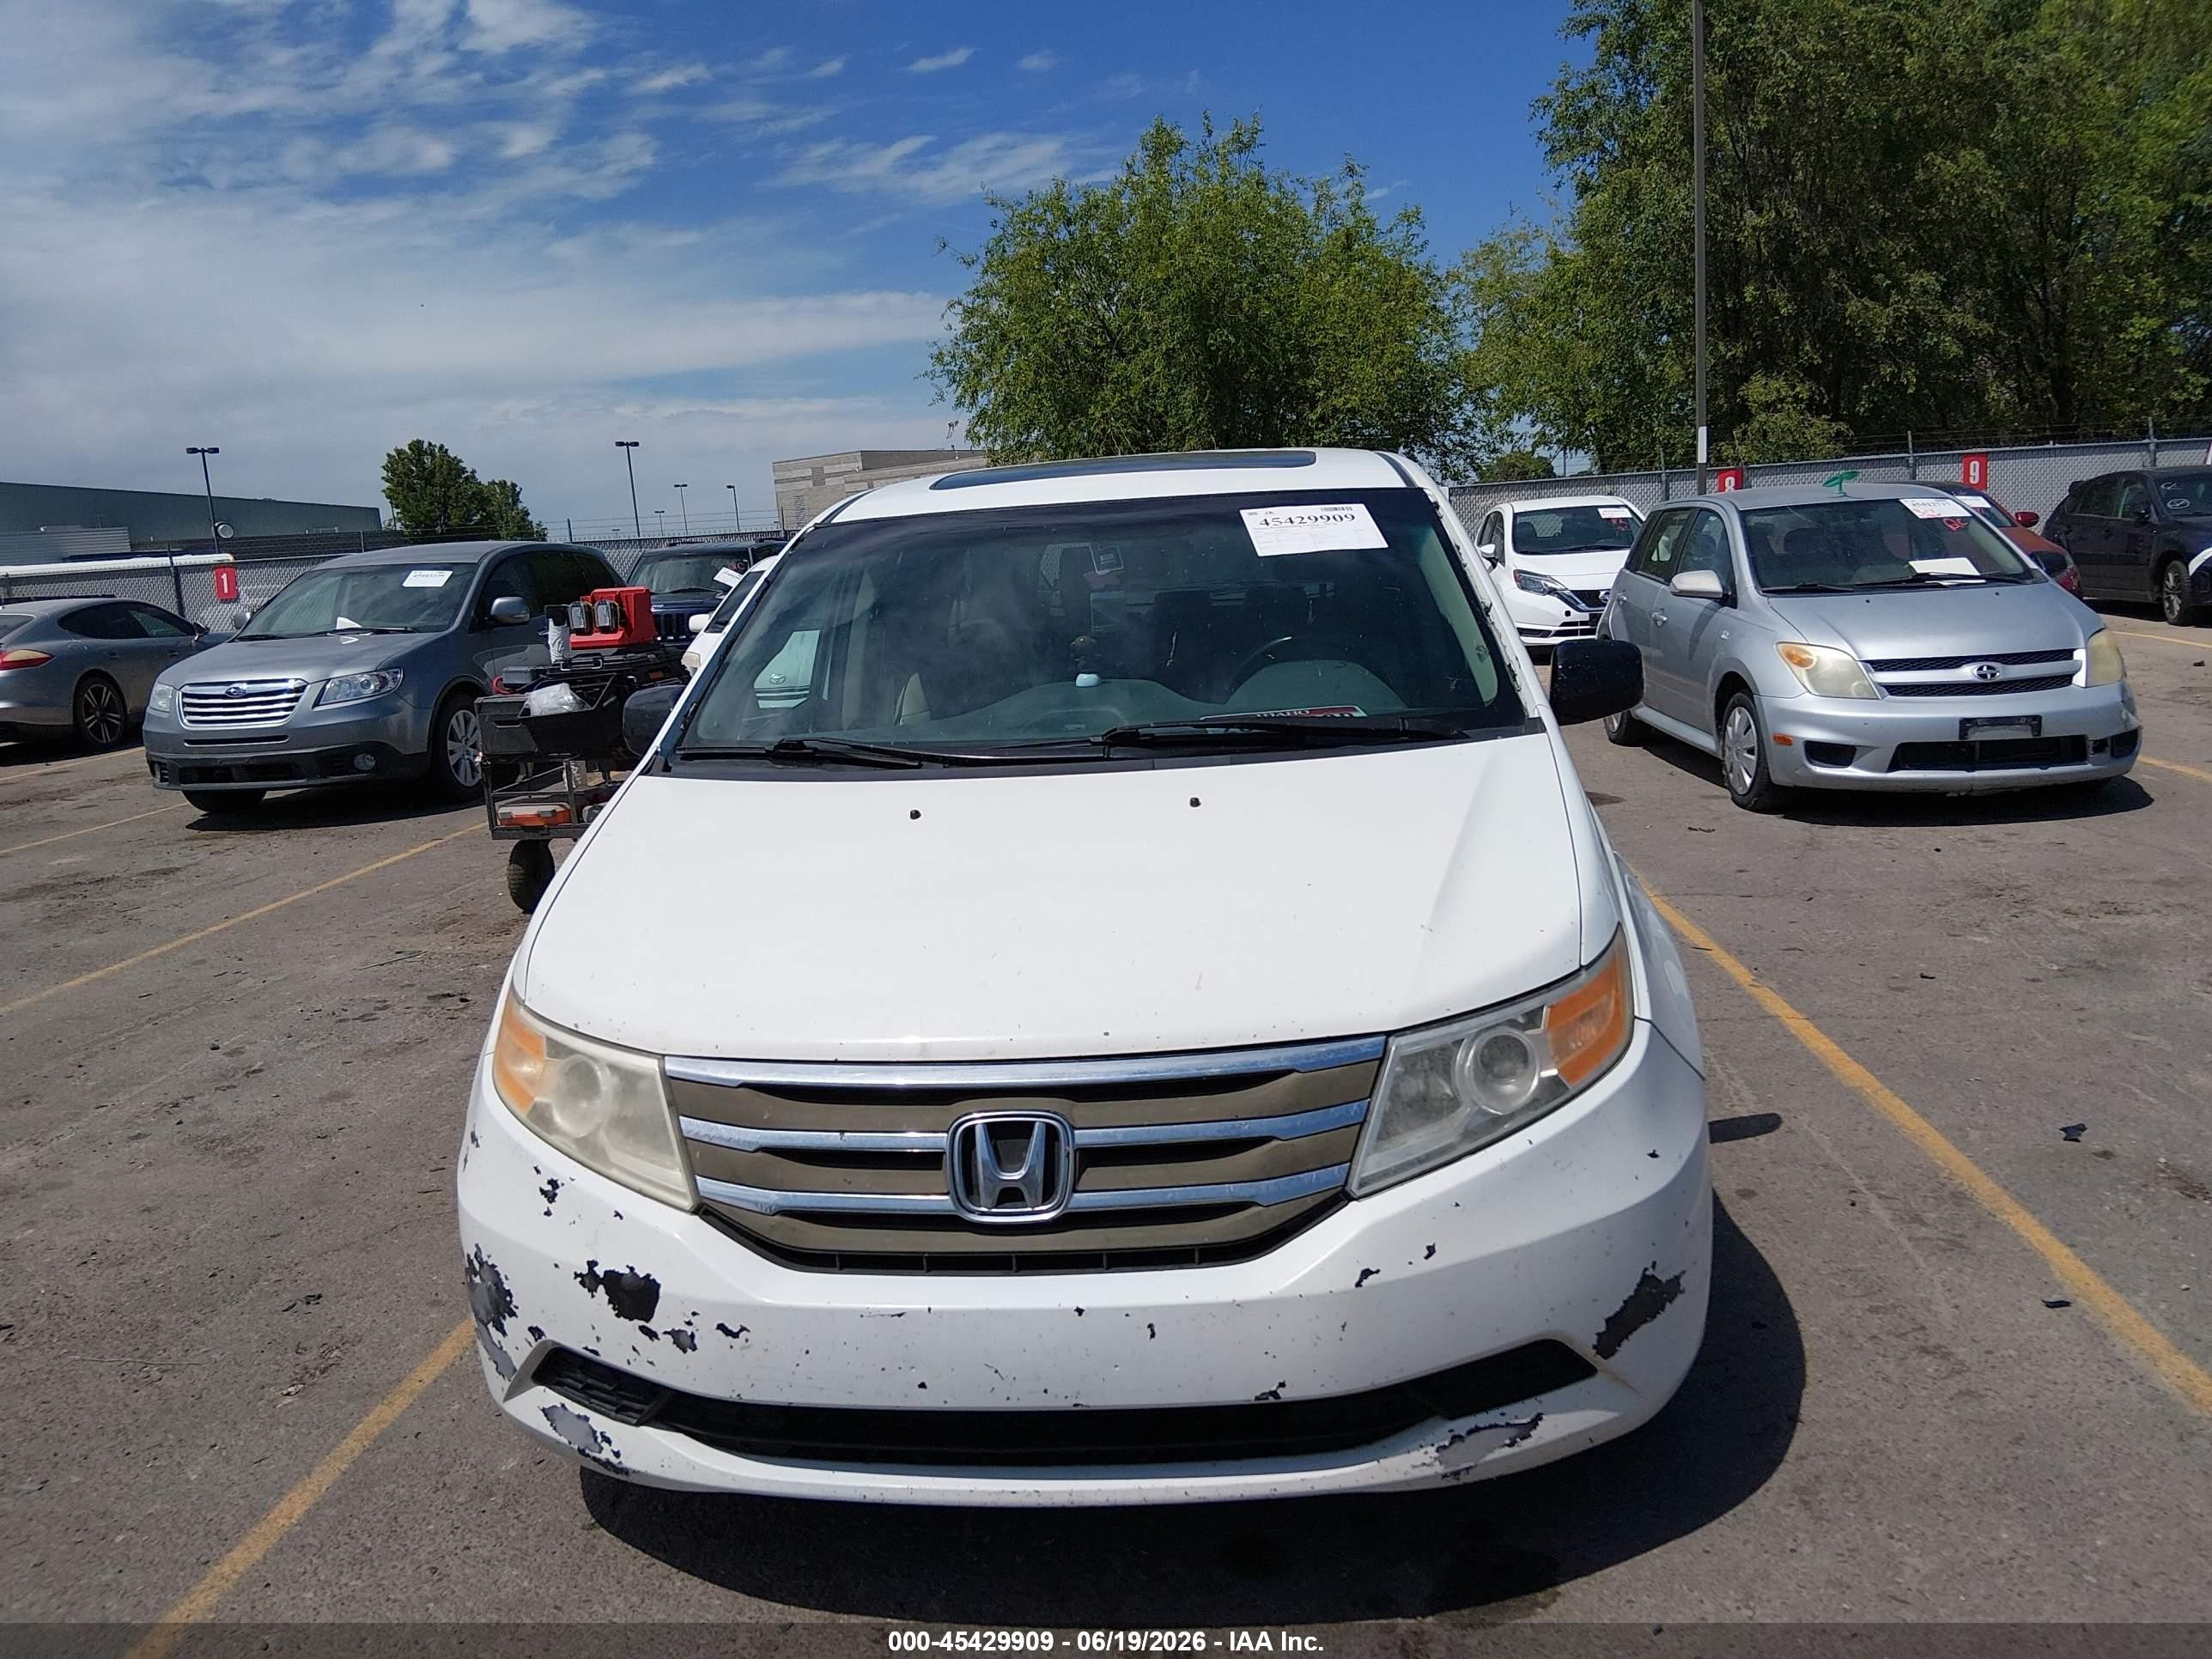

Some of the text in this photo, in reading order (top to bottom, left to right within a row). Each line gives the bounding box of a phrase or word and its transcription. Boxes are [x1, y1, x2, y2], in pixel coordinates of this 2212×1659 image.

[1969, 460, 1980, 484] 9
[1259, 514, 1355, 526] 45429909
[221, 572, 228, 593] 1
